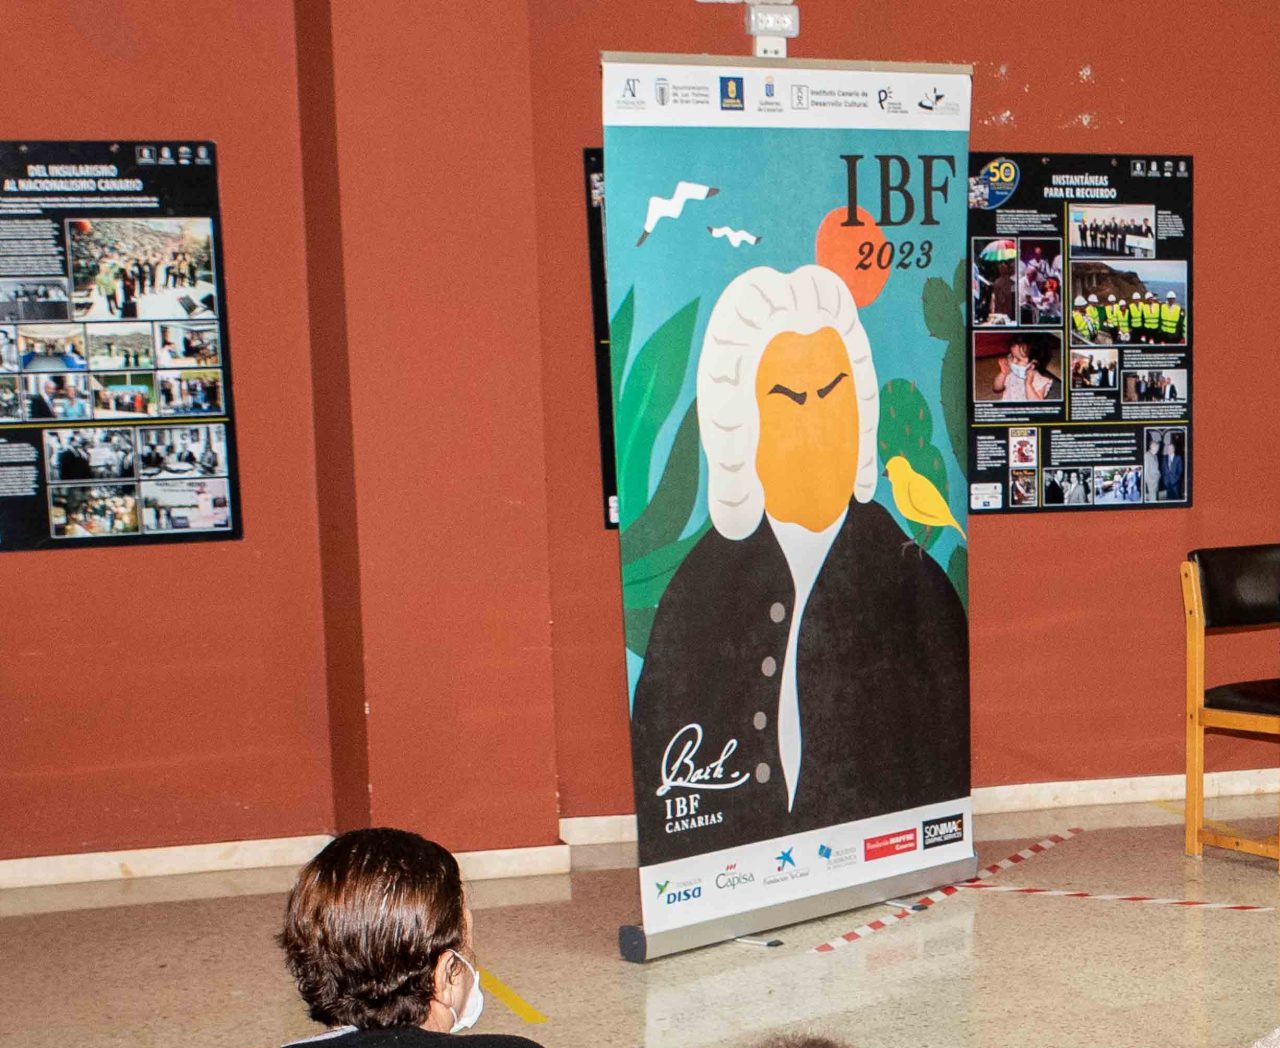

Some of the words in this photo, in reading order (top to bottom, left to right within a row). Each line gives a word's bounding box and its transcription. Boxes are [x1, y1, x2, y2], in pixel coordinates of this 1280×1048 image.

[810, 89, 836, 97] Instituto
[838, 90, 860, 98] Canario
[810, 100, 842, 108] Desarrollo
[844, 100, 868, 108] Cultural
[27, 164, 49, 178] DEL
[989, 162, 1015, 182] 50
[1052, 173, 1109, 187] INSTANTÁNEAS
[840, 154, 956, 227] IBF
[1043, 187, 1064, 199] PARA
[1065, 188, 1074, 199] EL
[1075, 188, 1117, 200] RECUERDO
[855, 239, 933, 271] 2023
[664, 794, 701, 820] IBF
[665, 812, 724, 834] CANARIAS
[889, 832, 915, 844] MAPFRE
[715, 872, 755, 890] Capisa
